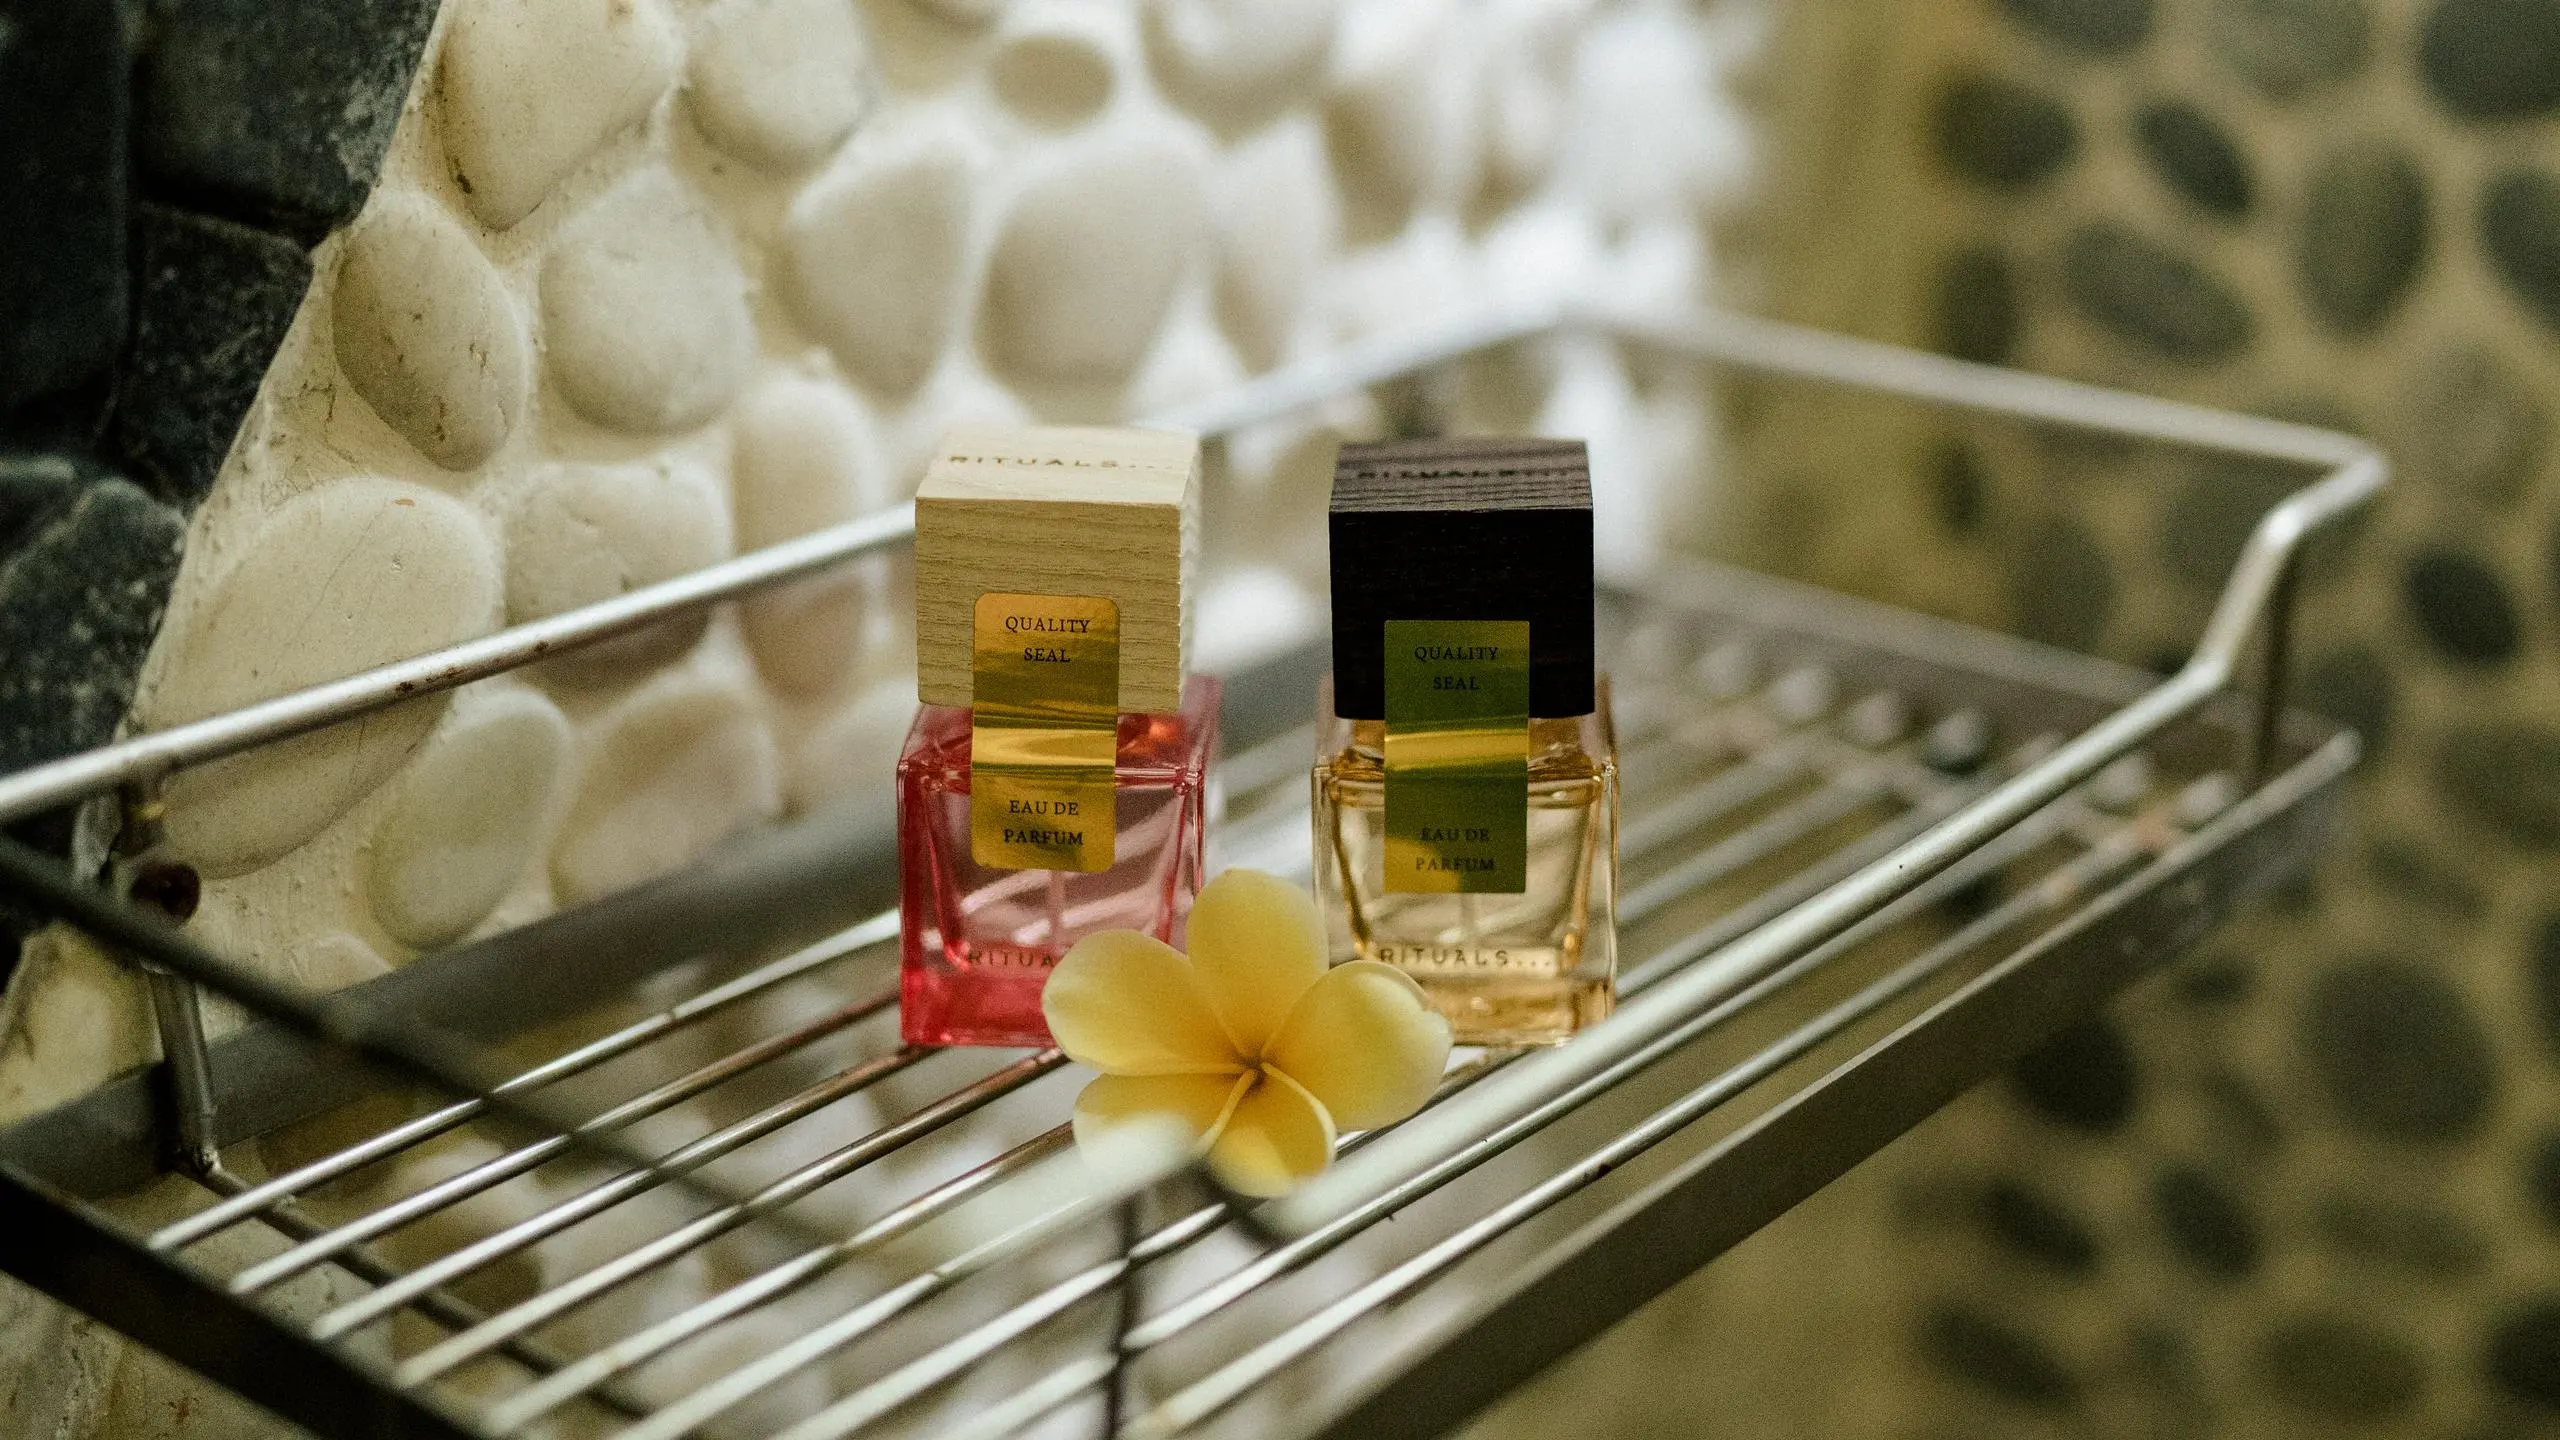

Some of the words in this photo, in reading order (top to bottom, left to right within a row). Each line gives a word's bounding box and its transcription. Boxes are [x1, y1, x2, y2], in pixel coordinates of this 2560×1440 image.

[1005, 616, 1090, 633] QUALITY
[1023, 647, 1071, 662] SEAL
[1414, 646, 1498, 662] QUALITY
[1432, 676, 1480, 690] SEAL
[1009, 800, 1049, 815] EAU
[1054, 802, 1079, 816] DE
[1004, 829, 1084, 846] PARFUM
[1419, 827, 1460, 842] EAU
[1465, 828, 1489, 842] DE
[1415, 857, 1495, 872] PARFUM
[969, 951, 1055, 968] RITUA
